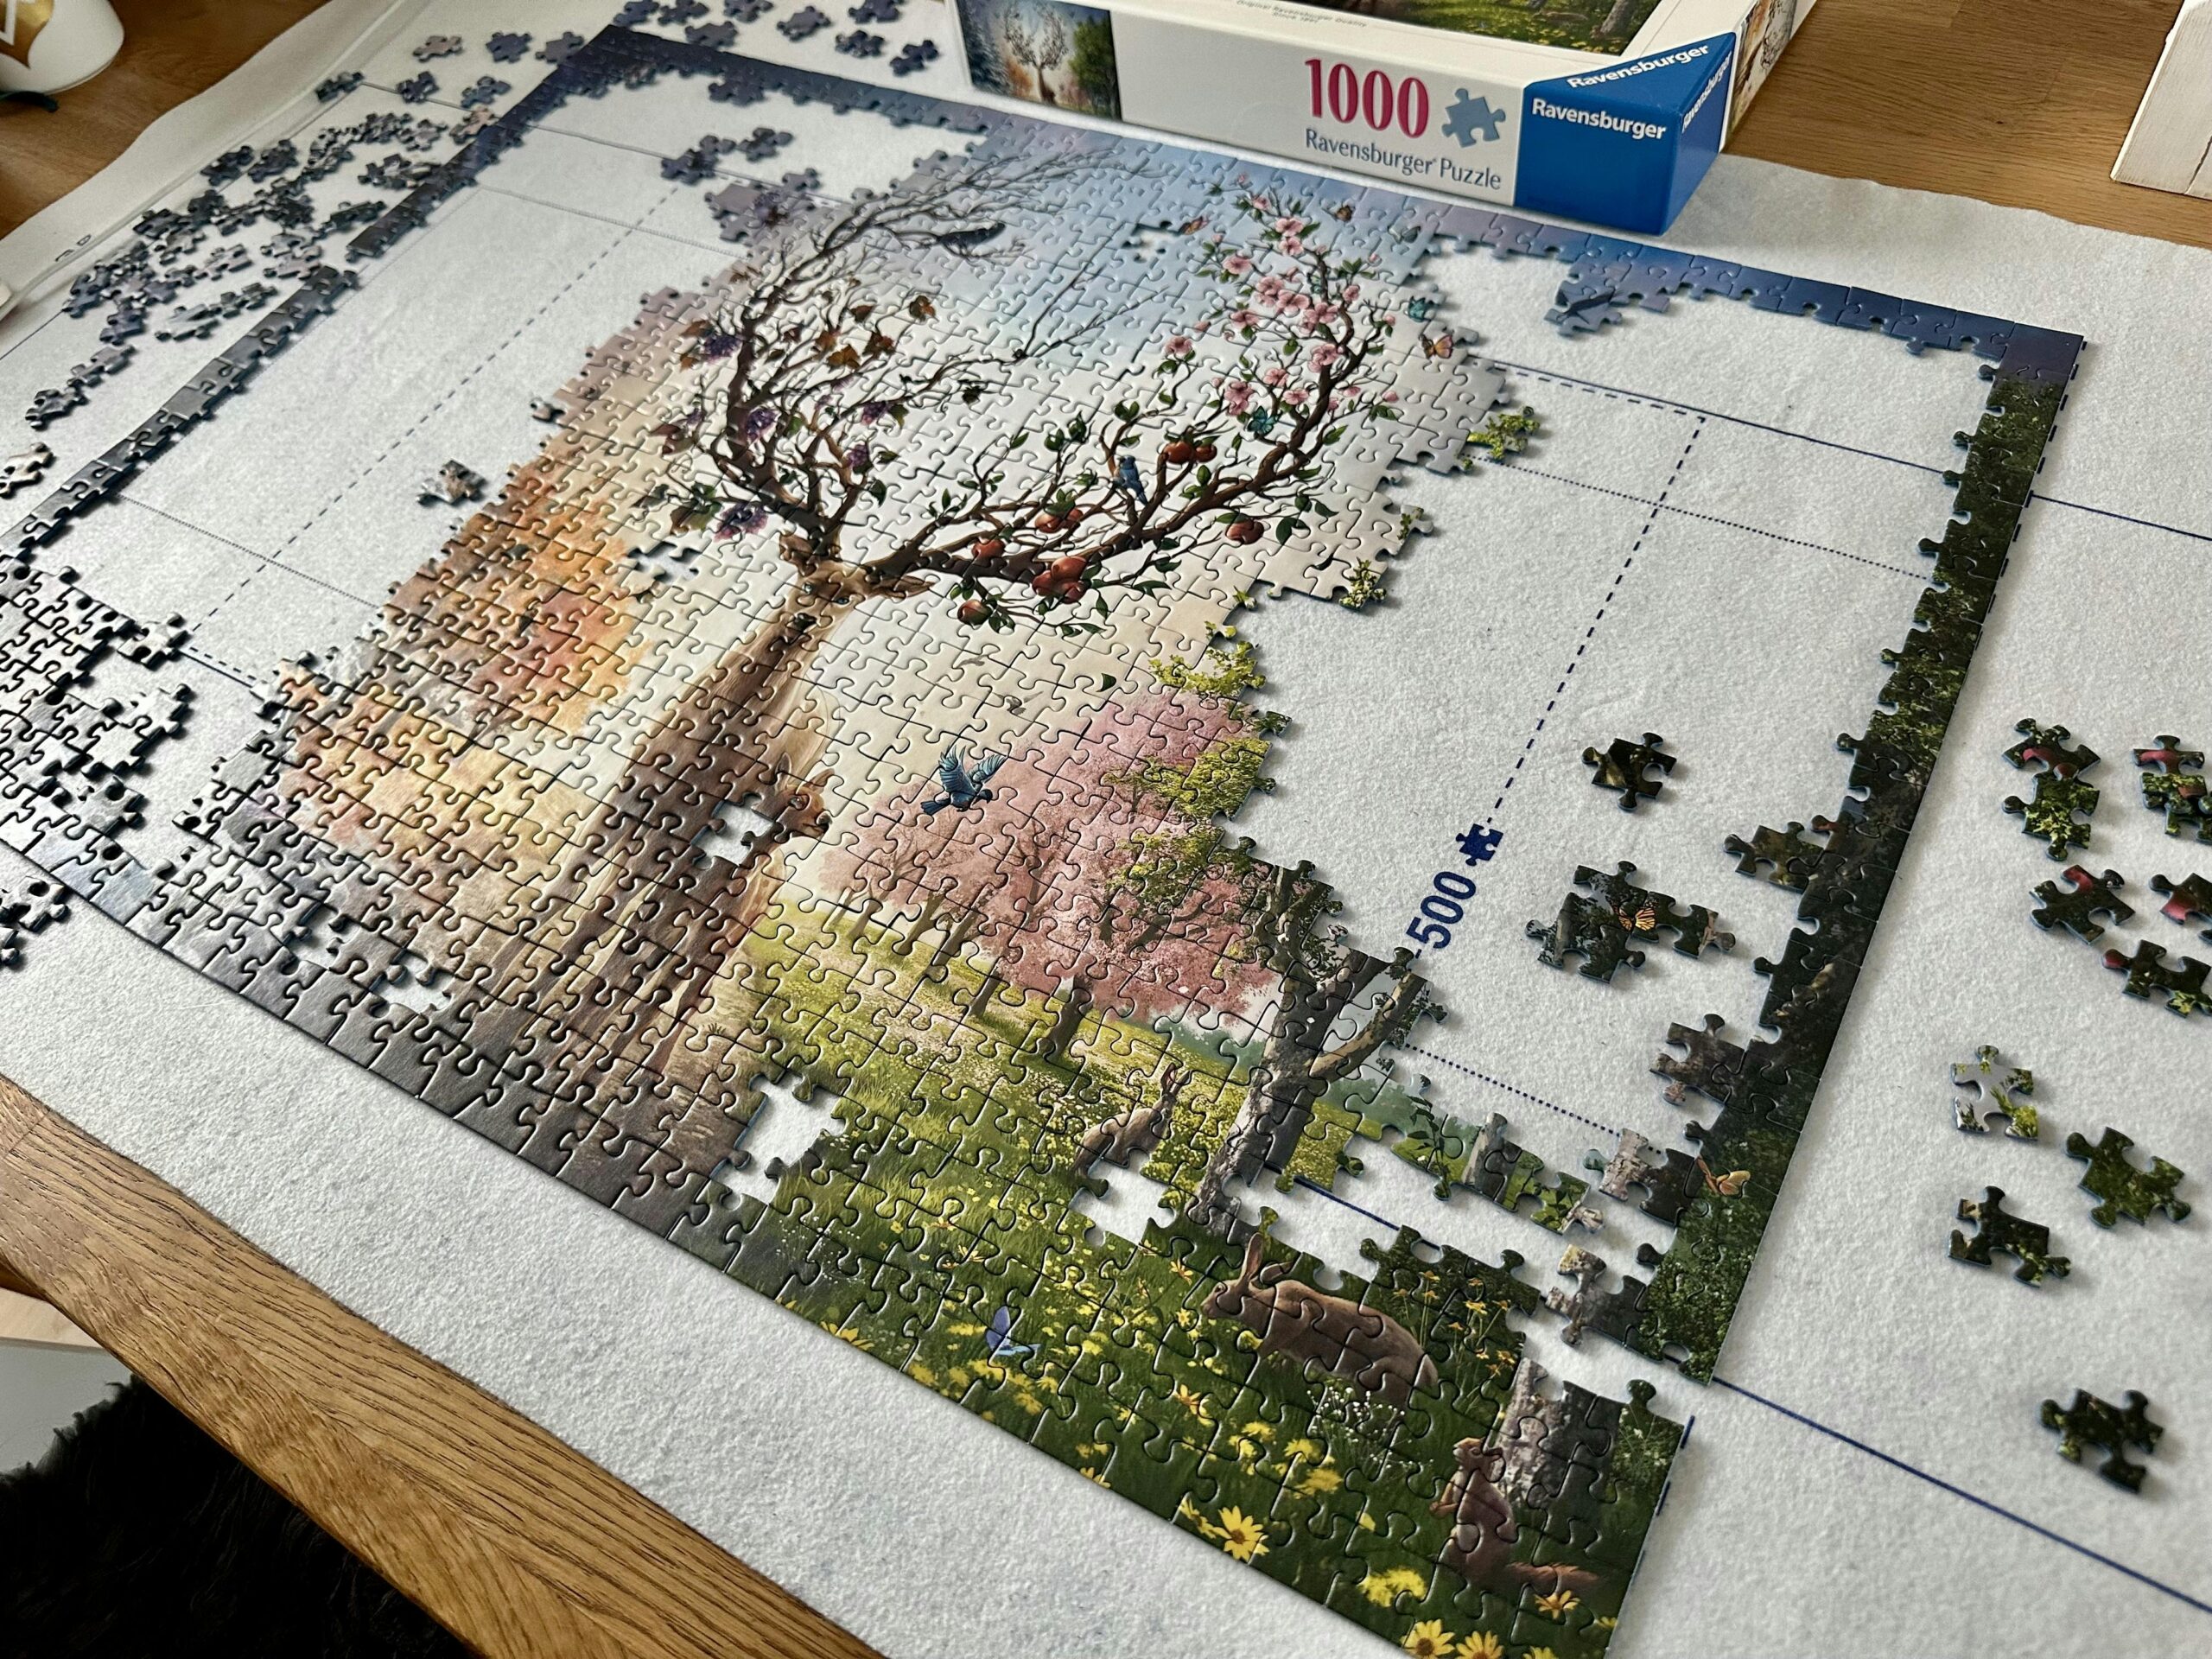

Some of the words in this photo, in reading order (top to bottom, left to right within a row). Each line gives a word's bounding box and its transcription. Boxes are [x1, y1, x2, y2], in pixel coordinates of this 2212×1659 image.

[1304, 58, 1430, 140] 1000
[1566, 43, 1710, 89] Ravensburger
[1681, 50, 1732, 134] Ravensburger
[1532, 97, 1667, 141] Ravensburger
[1306, 128, 1433, 176] Ravensburger
[1440, 157, 1502, 191] Puzzle
[1405, 871, 1477, 950] 500
